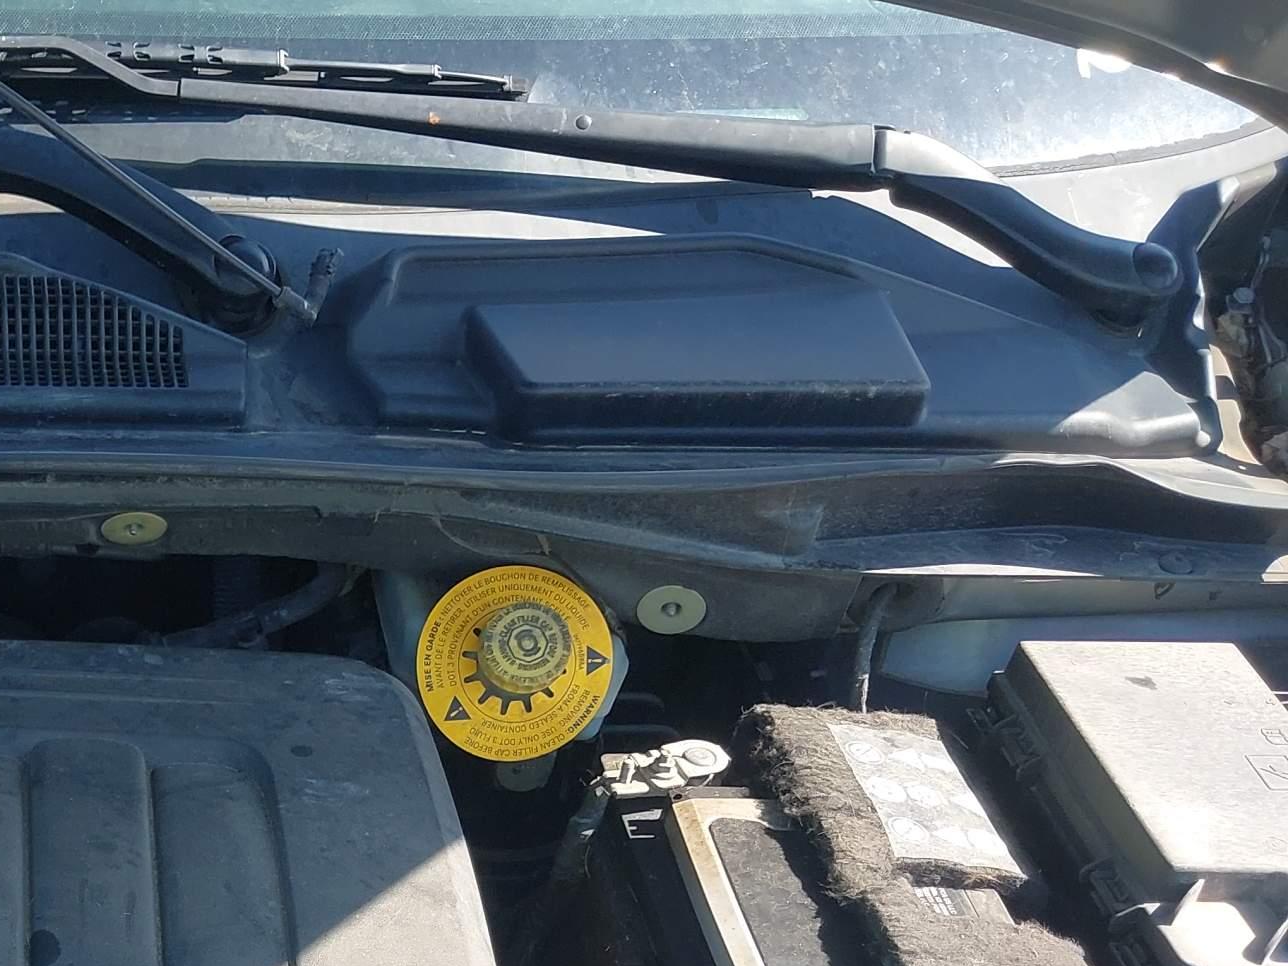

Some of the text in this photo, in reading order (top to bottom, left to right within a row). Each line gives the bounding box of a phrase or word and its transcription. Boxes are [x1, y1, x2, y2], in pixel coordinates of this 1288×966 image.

[484, 572, 526, 586] BOUCHON
[528, 573, 539, 581] DE
[474, 581, 484, 590] LE
[498, 583, 553, 598] UNIQUEMENT
[541, 575, 590, 609] REMPLISSAGE
[441, 585, 474, 616] NETTOYER
[464, 587, 497, 608] UTILISER
[553, 593, 566, 604] DU
[471, 602, 491, 616] D'UN
[566, 603, 590, 630] LIQUIDE
[438, 638, 446, 647] LE
[447, 614, 472, 660] PROVENANT
[424, 654, 432, 666] EN
[435, 649, 444, 660] DE
[424, 667, 434, 692] MISE
[435, 662, 444, 688] AVANT
[447, 671, 457, 687] DOT
[563, 683, 580, 707] FROM
[529, 710, 558, 730] SEALED
[469, 727, 491, 742] FLUID
[541, 726, 558, 737] USE
[463, 736, 493, 754] BEFORE
[492, 736, 498, 744] 3
[518, 734, 539, 745] ONLY
[540, 733, 565, 749] CLEAN
[494, 748, 511, 757] CAP
[512, 745, 539, 757] FILLER
